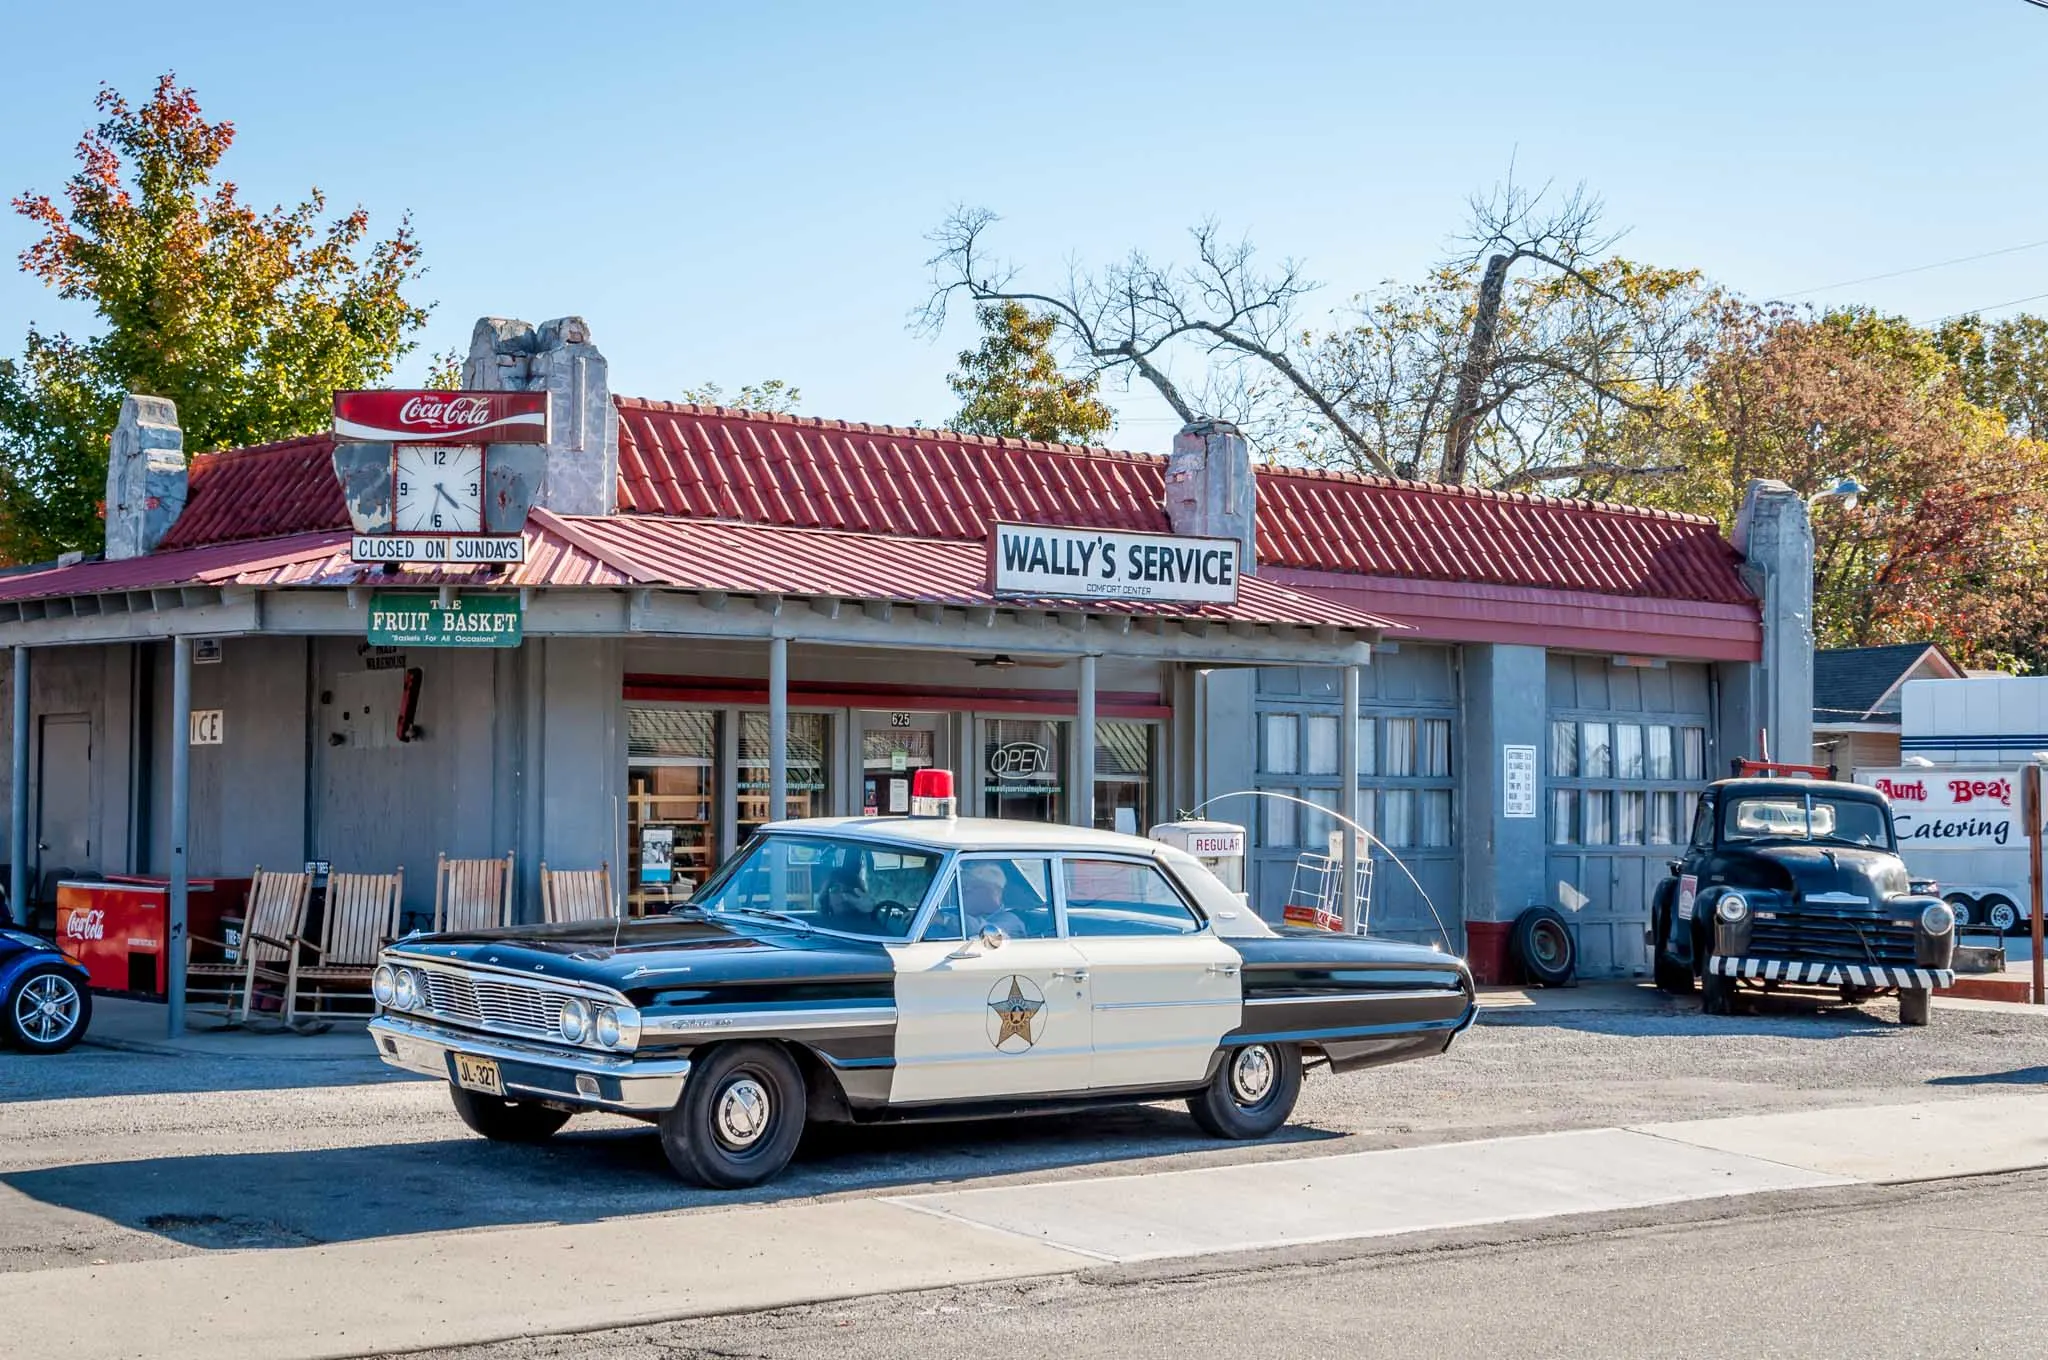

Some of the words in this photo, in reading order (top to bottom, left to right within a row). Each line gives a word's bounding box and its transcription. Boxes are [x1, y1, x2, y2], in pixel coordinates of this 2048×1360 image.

[400, 397, 489, 424] Coca-Cola
[434, 451, 446, 465] 12
[400, 482, 408, 496] 9
[470, 483, 478, 496] 3
[434, 514, 442, 528] 6
[359, 539, 415, 558] CLOSED
[425, 540, 445, 558] ON
[456, 541, 518, 559] SUNDAYS
[1002, 534, 1116, 579] WALLY'S
[1128, 545, 1233, 586] SERVICE
[1087, 583, 1121, 595] COMFORT
[1123, 585, 1152, 596] CENTER
[430, 599, 462, 610] TE
[372, 612, 430, 632] FRUIT
[443, 612, 517, 632] BASKET
[425, 634, 437, 642] For
[441, 634, 451, 642] All
[192, 713, 218, 741] ICE
[892, 713, 910, 726] 625
[991, 749, 1049, 772] OPEN
[1875, 779, 1928, 803] Aunt
[1948, 778, 2011, 807] Bea's
[1893, 815, 2010, 845] Catering
[1196, 838, 1241, 852] REGULAR
[67, 908, 105, 940] Coca-Cola
